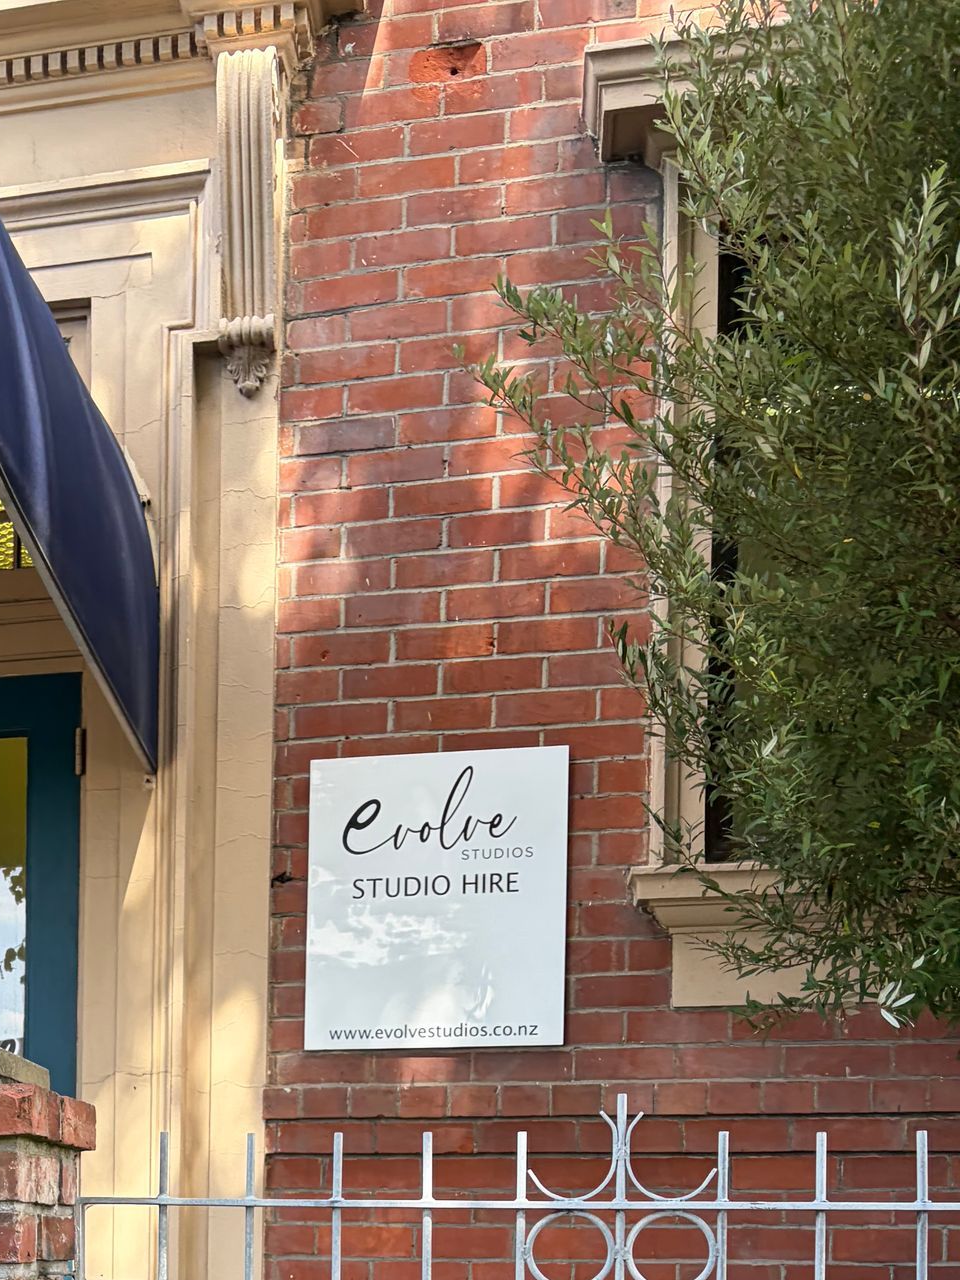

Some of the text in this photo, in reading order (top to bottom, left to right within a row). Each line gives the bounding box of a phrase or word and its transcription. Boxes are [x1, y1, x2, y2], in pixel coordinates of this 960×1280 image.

[461, 846, 534, 861] STUDIOS
[352, 872, 520, 899] STUDIO HIRE
[329, 1022, 539, 1040] www.evolvestudios.co.nz
